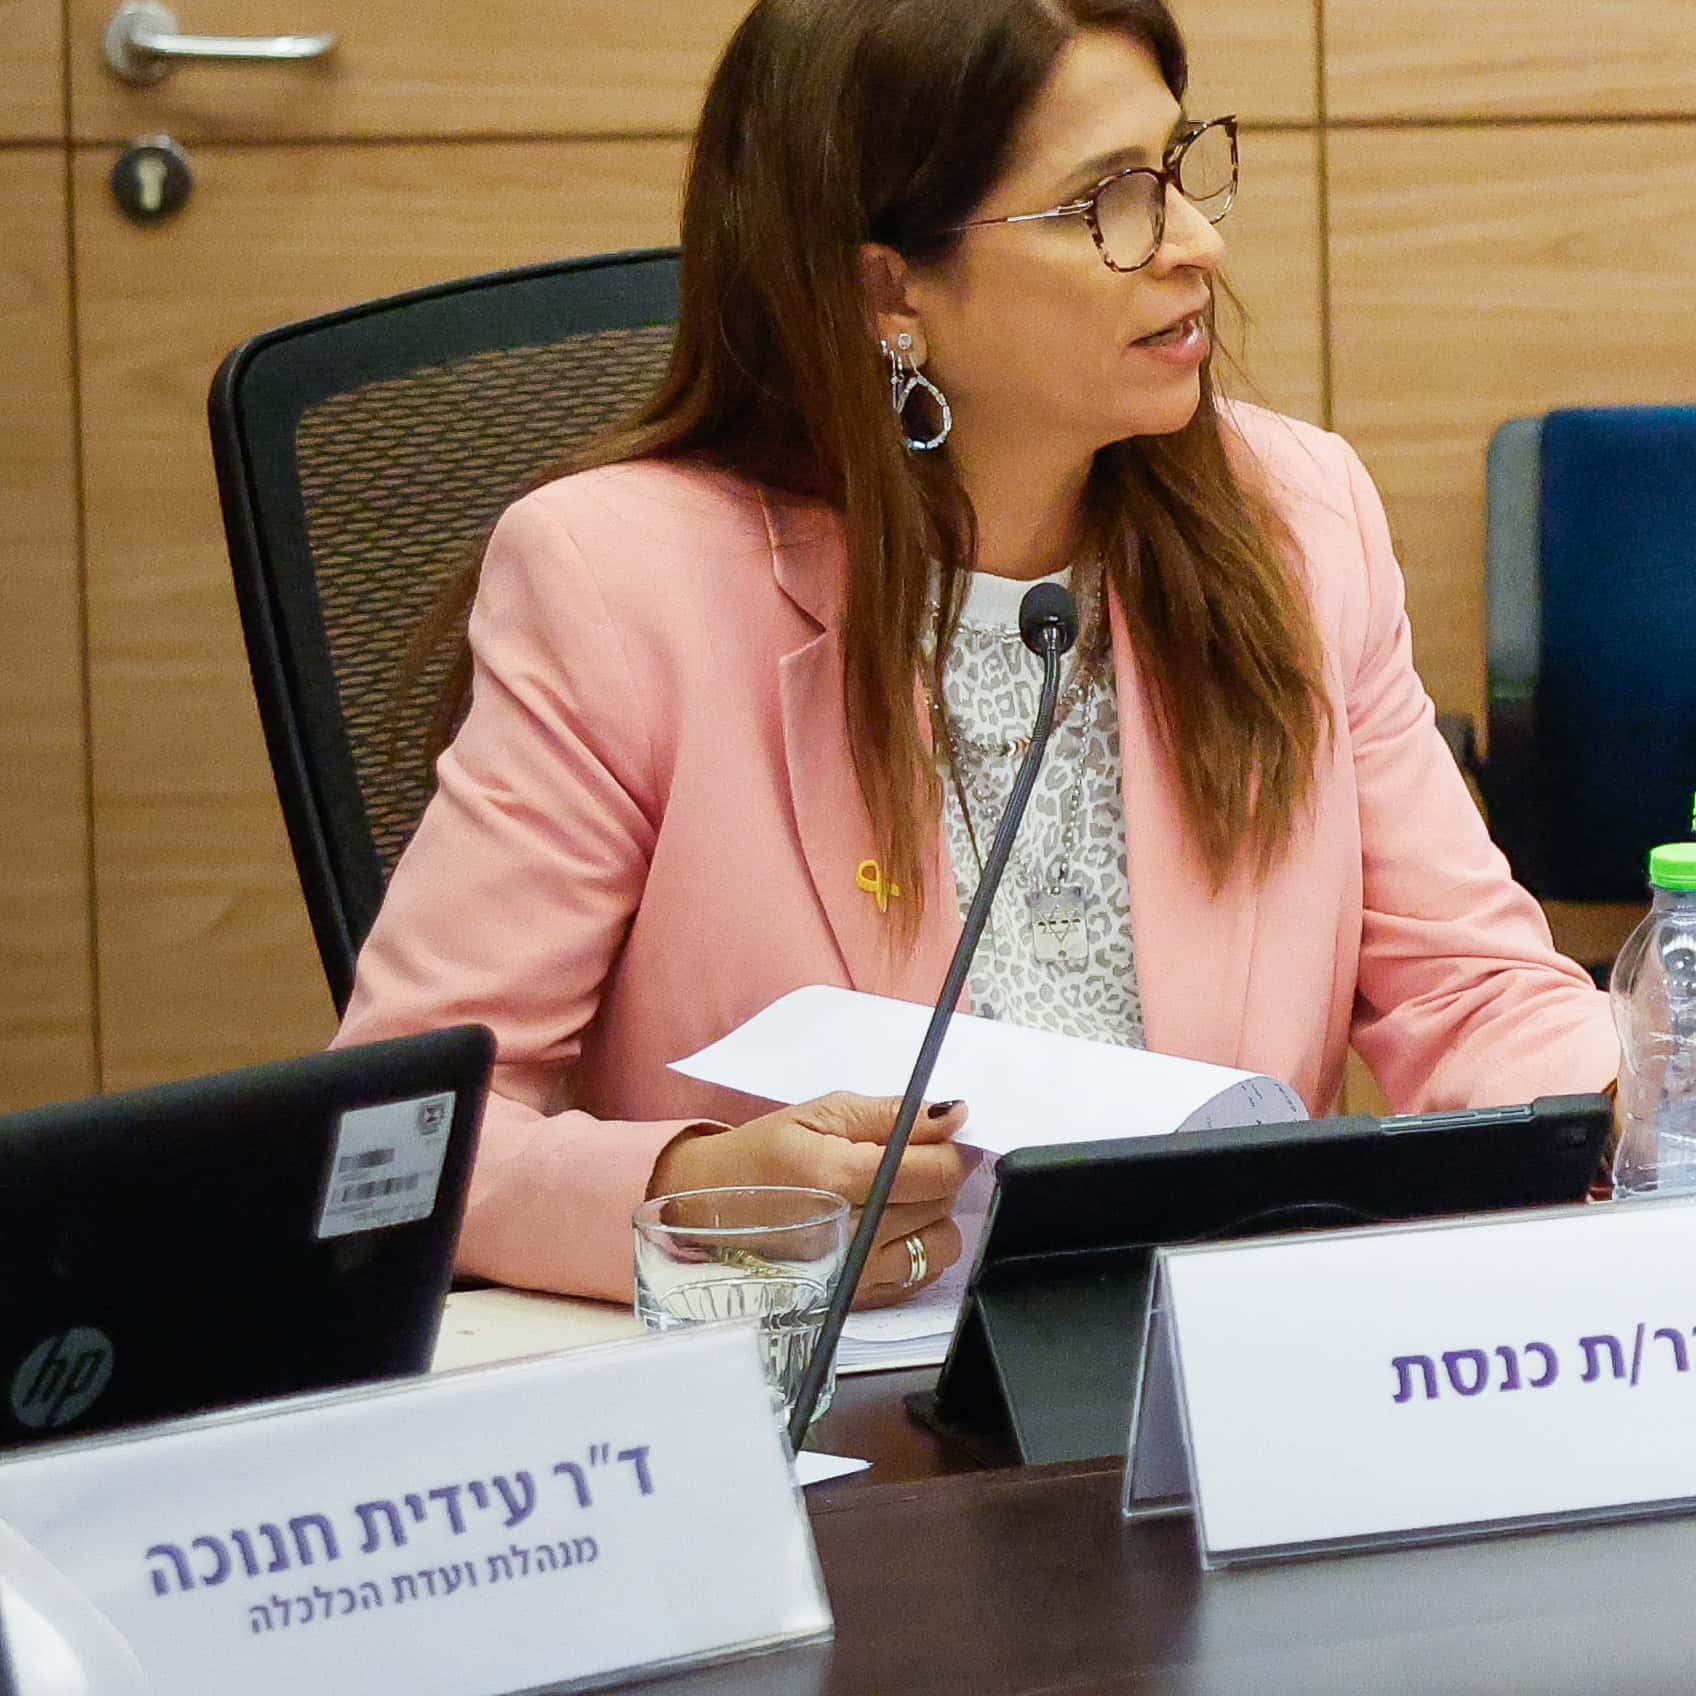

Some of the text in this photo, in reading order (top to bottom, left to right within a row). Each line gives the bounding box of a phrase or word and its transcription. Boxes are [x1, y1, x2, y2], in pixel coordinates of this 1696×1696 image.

[21, 1334, 107, 1425] hp
[1391, 1341, 1560, 1404] כנסת
[144, 1442, 655, 1596] ד"ר עידית חנוכה
[247, 1534, 600, 1635] מנהלת ועדת הכלכלה
